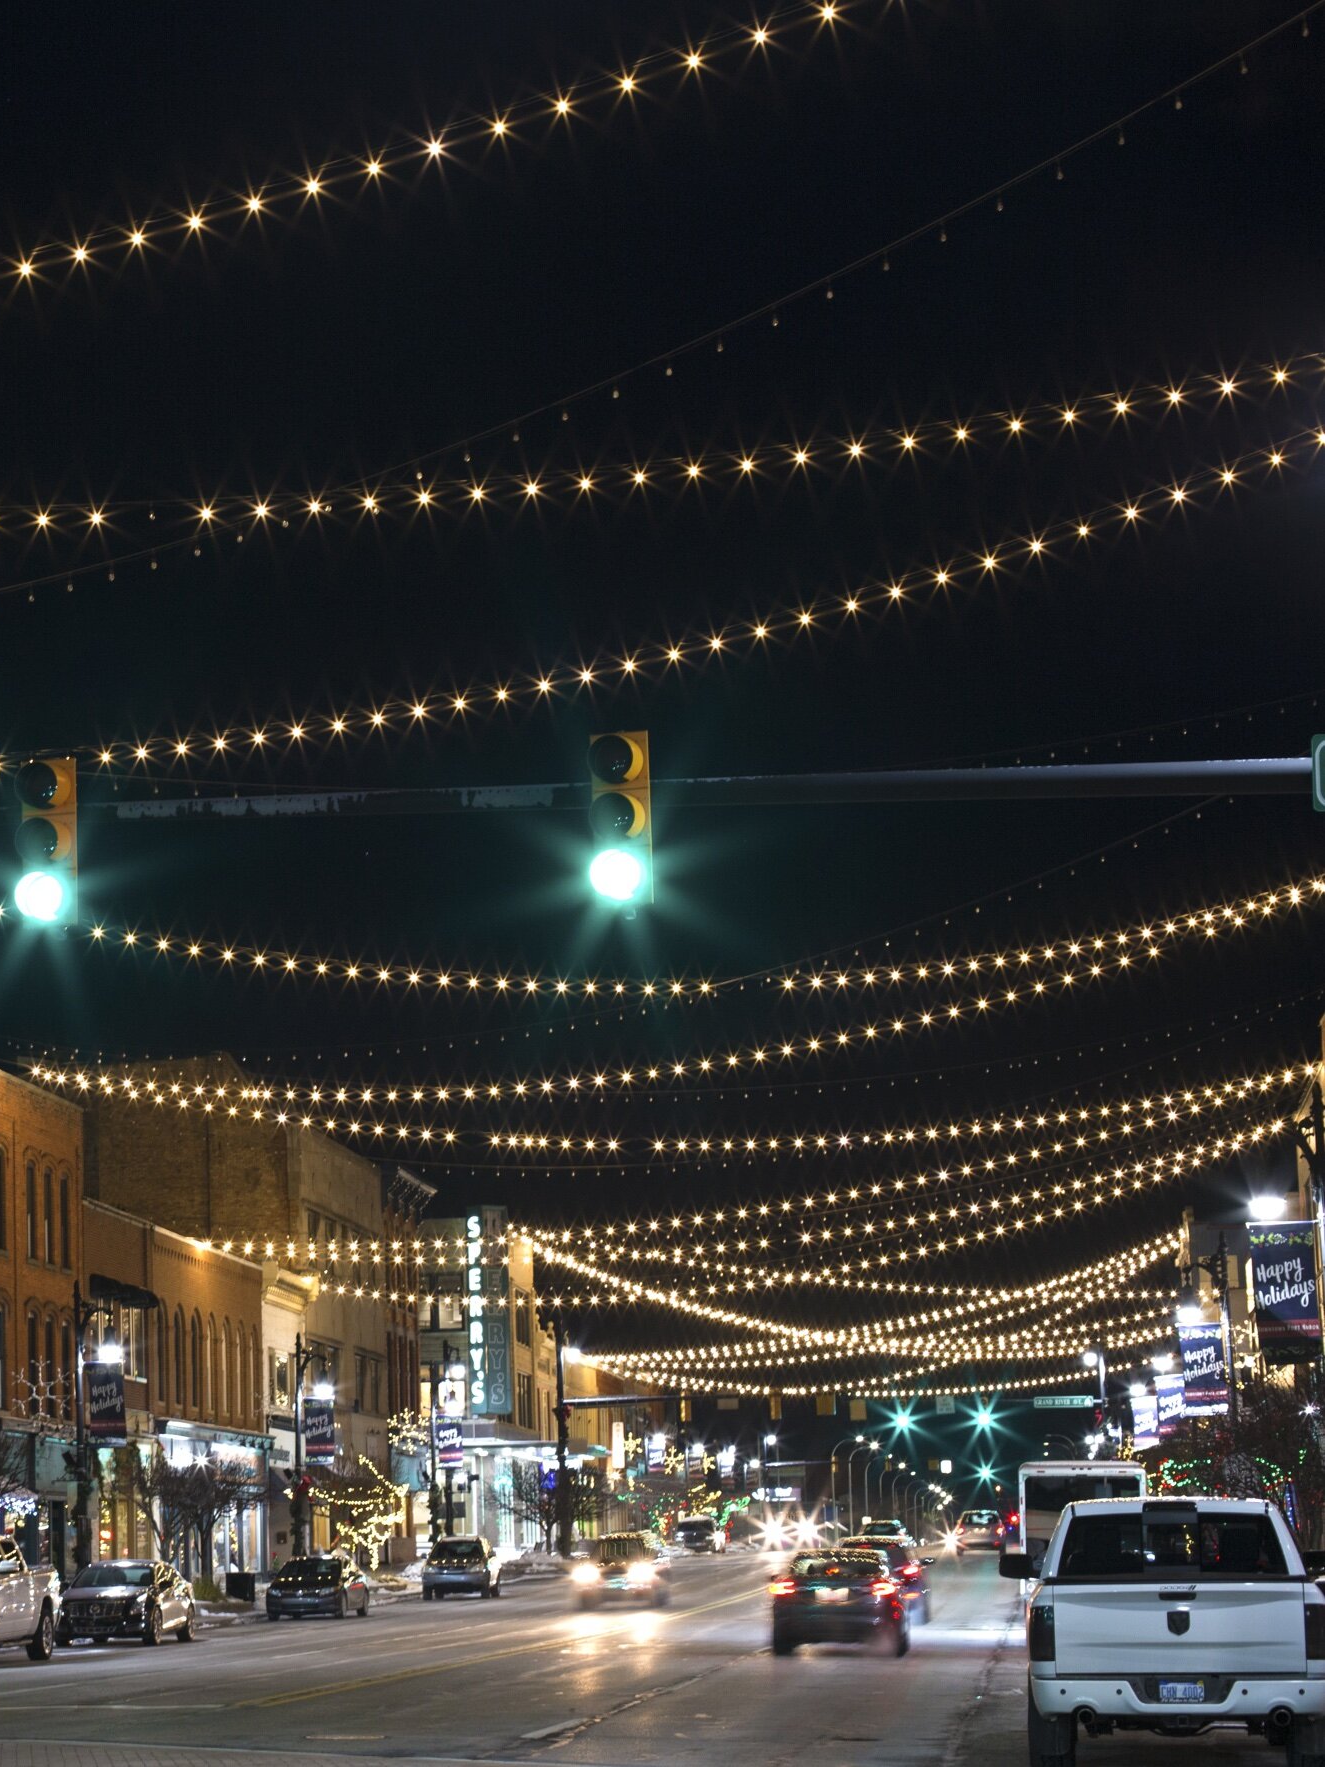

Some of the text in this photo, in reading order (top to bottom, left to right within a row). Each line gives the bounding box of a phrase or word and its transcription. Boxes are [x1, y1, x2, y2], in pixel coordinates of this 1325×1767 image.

[1257, 1257, 1305, 1283] Happy
[1255, 1279, 1315, 1310] Holidays
[466, 1215, 485, 1405] SPERRY'S
[1184, 1345, 1217, 1363] Happy
[1183, 1360, 1225, 1382] Holidays
[92, 1381, 117, 1397] Happy
[90, 1395, 124, 1414] Holidays
[306, 1413, 329, 1426] Happy
